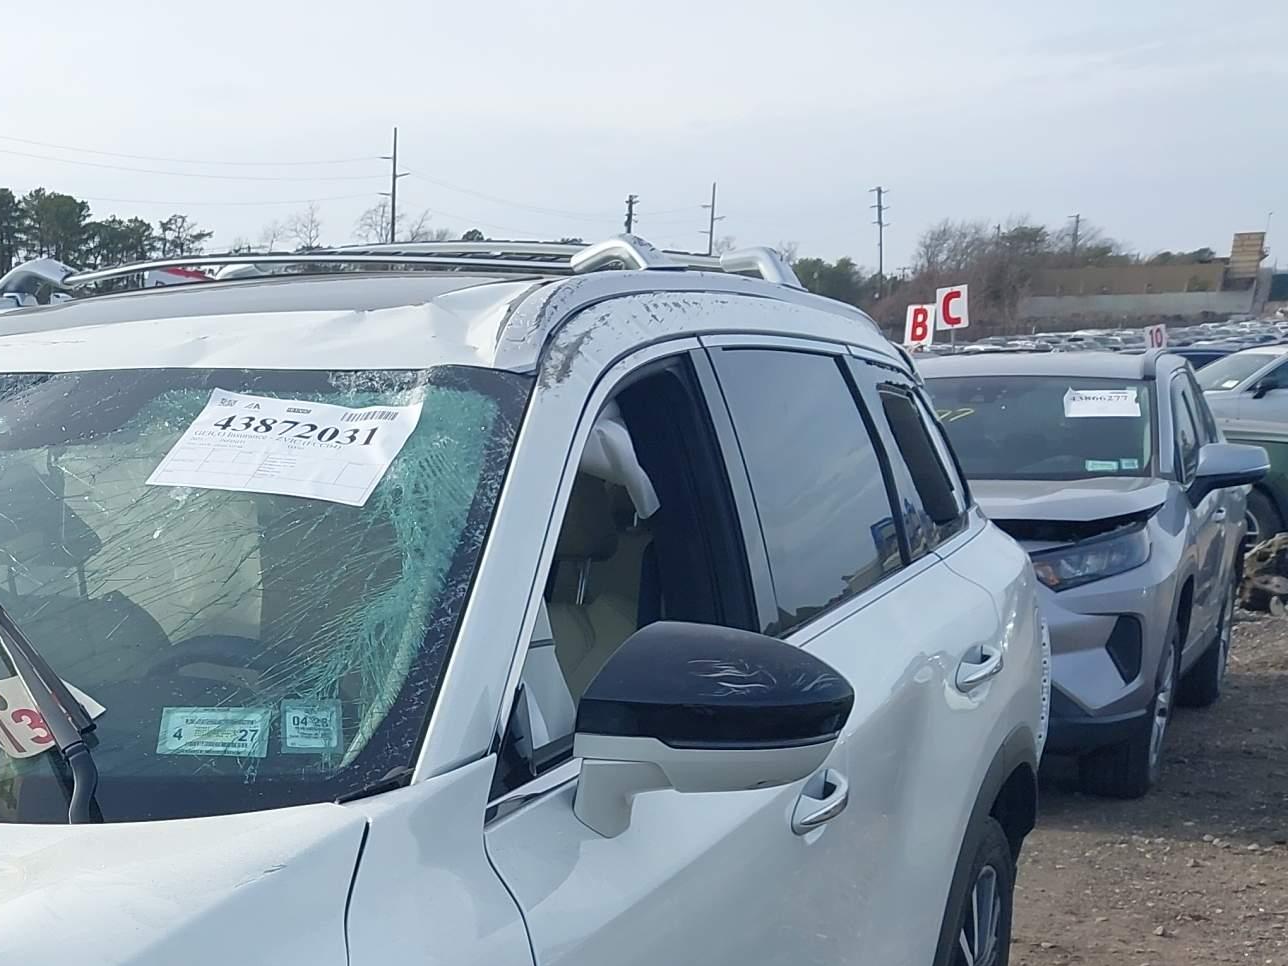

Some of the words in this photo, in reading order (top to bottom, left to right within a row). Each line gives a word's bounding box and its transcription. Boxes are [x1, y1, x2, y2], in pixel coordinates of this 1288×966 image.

[942, 290, 962, 325] C
[911, 308, 928, 342] B
[1149, 327, 1163, 348] 10
[213, 415, 379, 446] 43872031
[172, 728, 184, 741] 4
[237, 729, 260, 742] 27
